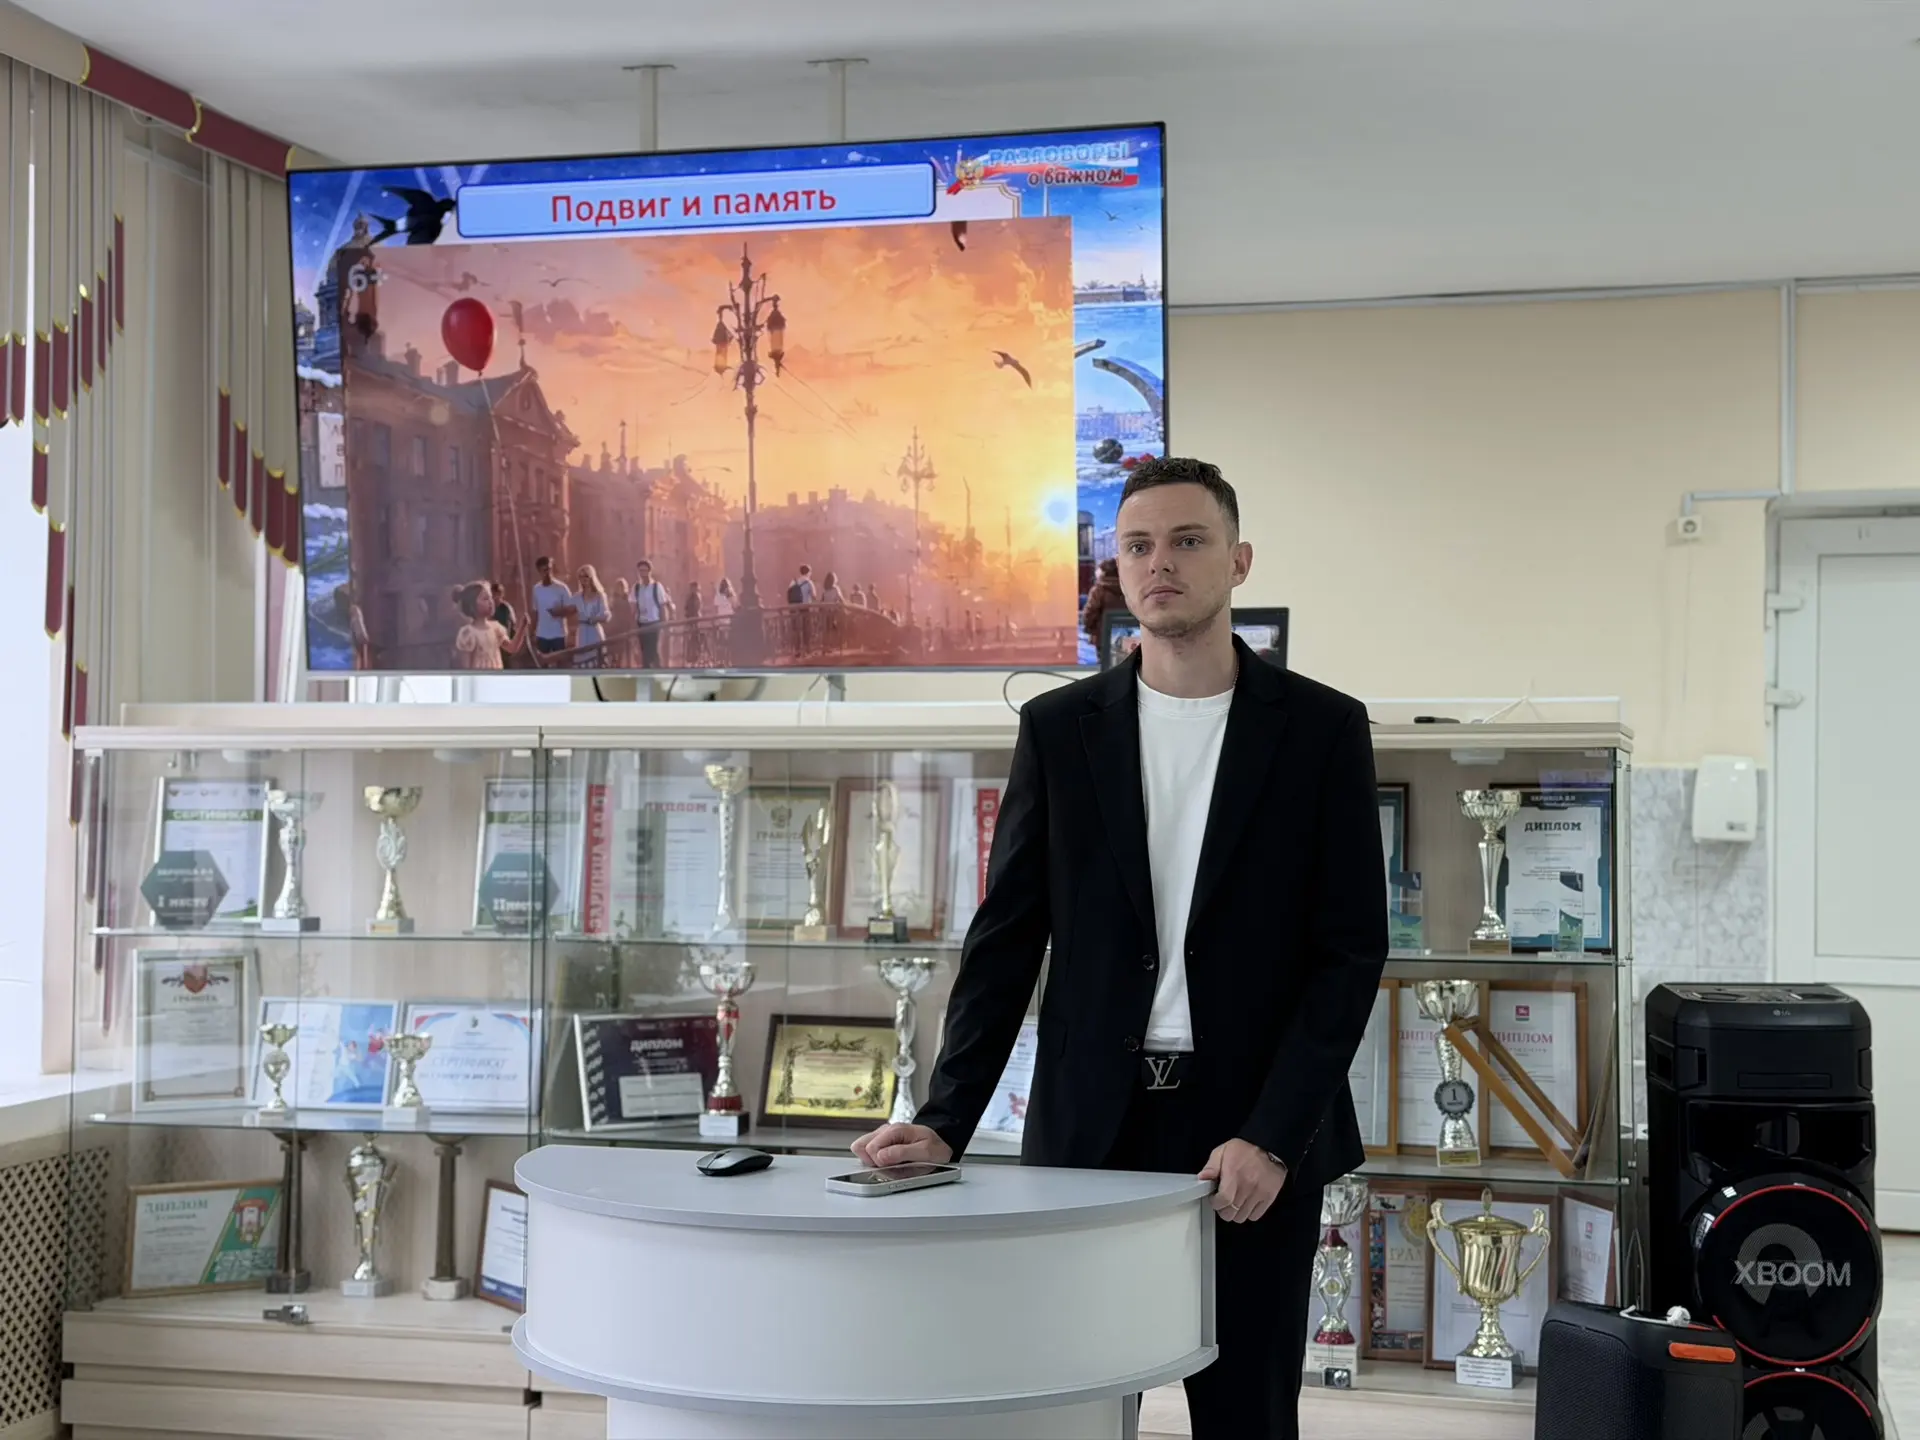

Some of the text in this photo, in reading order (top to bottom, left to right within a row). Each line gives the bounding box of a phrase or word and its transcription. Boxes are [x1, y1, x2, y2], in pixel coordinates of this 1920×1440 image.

[988, 141, 1129, 166] РАЗГОВОРЫ
[1028, 167, 1124, 187] о важном
[551, 189, 837, 227] Подвиг и память
[348, 263, 389, 293] 6+
[1524, 821, 1582, 832] ДИПЛОМ
[144, 1199, 208, 1214] ДИПЛОМ
[1733, 1260, 1851, 1287] XBOOM
